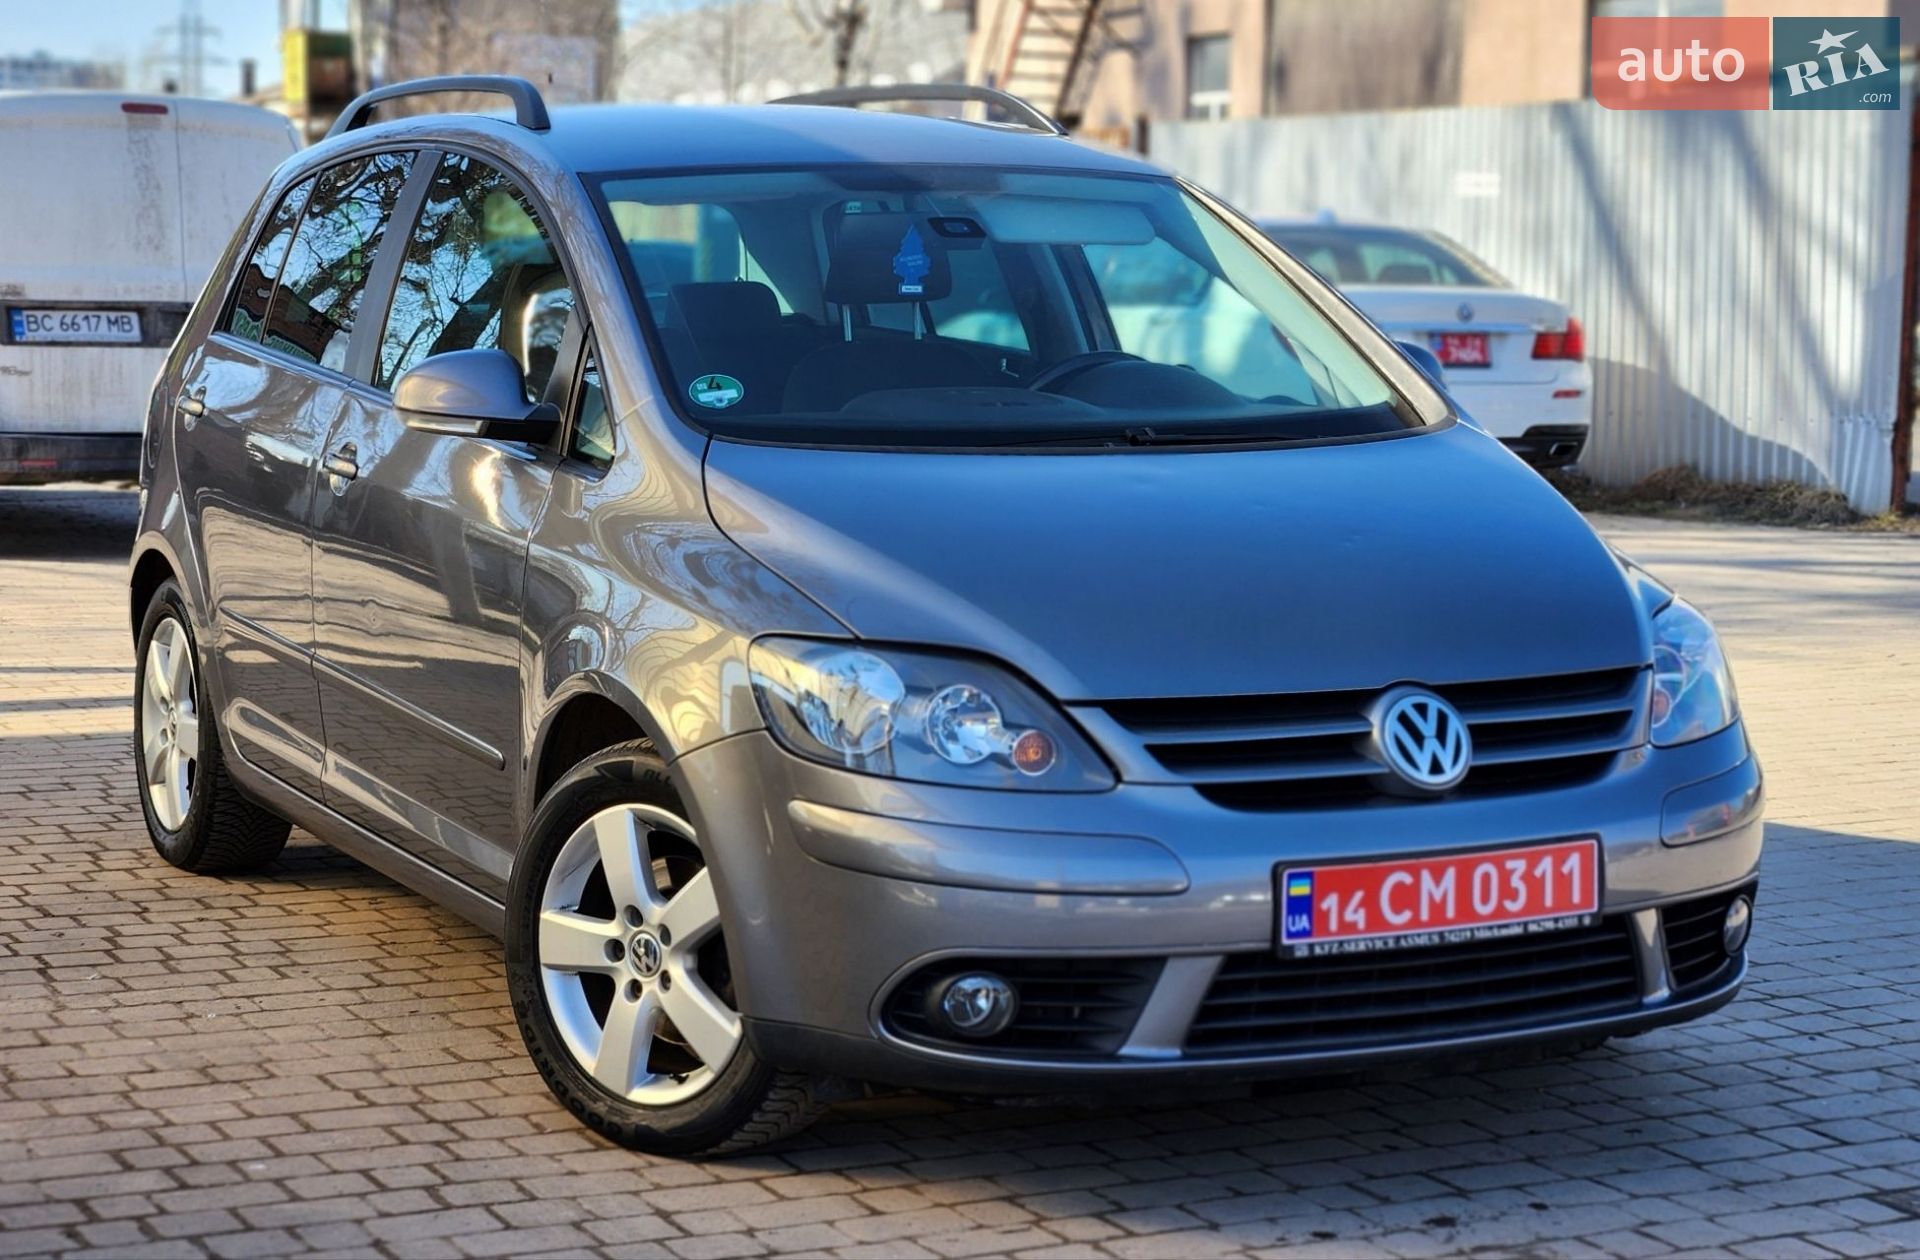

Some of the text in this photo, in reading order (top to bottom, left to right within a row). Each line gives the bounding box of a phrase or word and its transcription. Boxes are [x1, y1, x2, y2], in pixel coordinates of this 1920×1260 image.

[26, 314, 134, 333] BC 6617 MB
[1320, 851, 1582, 933] 14 CM 0311
[1288, 913, 1310, 932] UA
